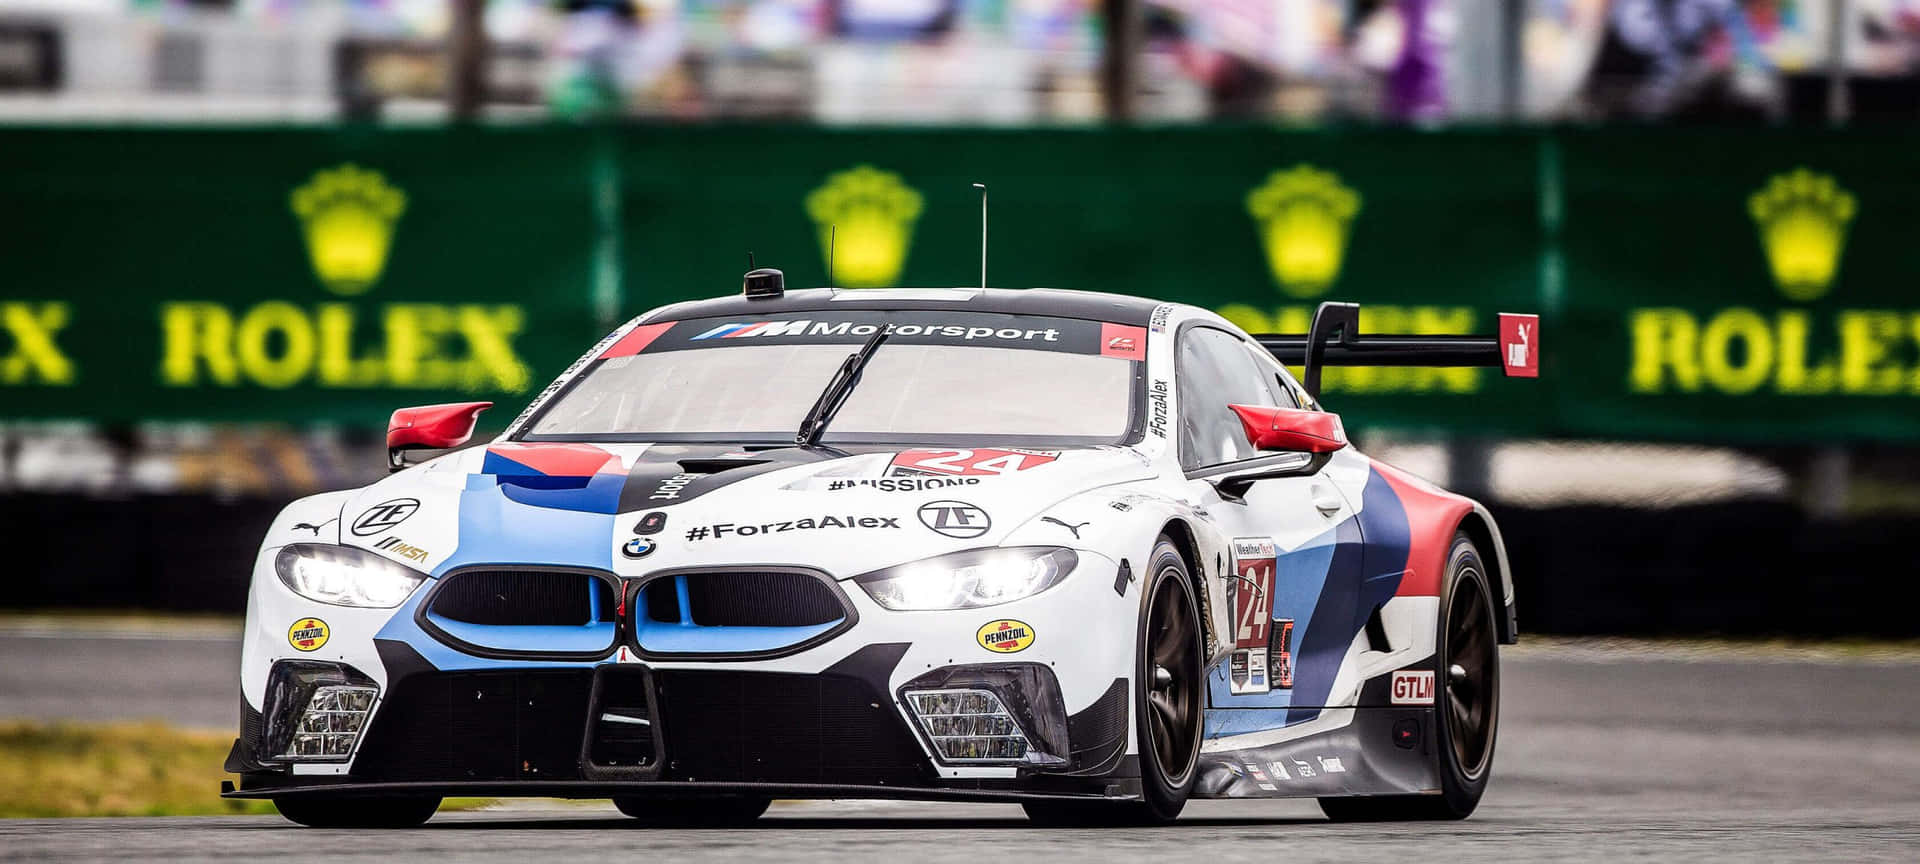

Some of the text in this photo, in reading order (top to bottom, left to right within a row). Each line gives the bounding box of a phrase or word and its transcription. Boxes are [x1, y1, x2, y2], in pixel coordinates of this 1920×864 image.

[809, 321, 1060, 342] Motorsport
[163, 301, 529, 391] ROLEX
[1630, 307, 1920, 395] ROLE
[1150, 379, 1168, 440] #ForzaAlex
[914, 449, 1027, 473] 24
[355, 503, 419, 530] ZF
[685, 514, 901, 542] #ForzaAlex
[921, 506, 989, 530] ZF
[1238, 566, 1270, 640] 24
[292, 627, 324, 641] PENNZOIL
[985, 627, 1027, 645] PENNZOIL
[1394, 676, 1434, 699] GTLM
